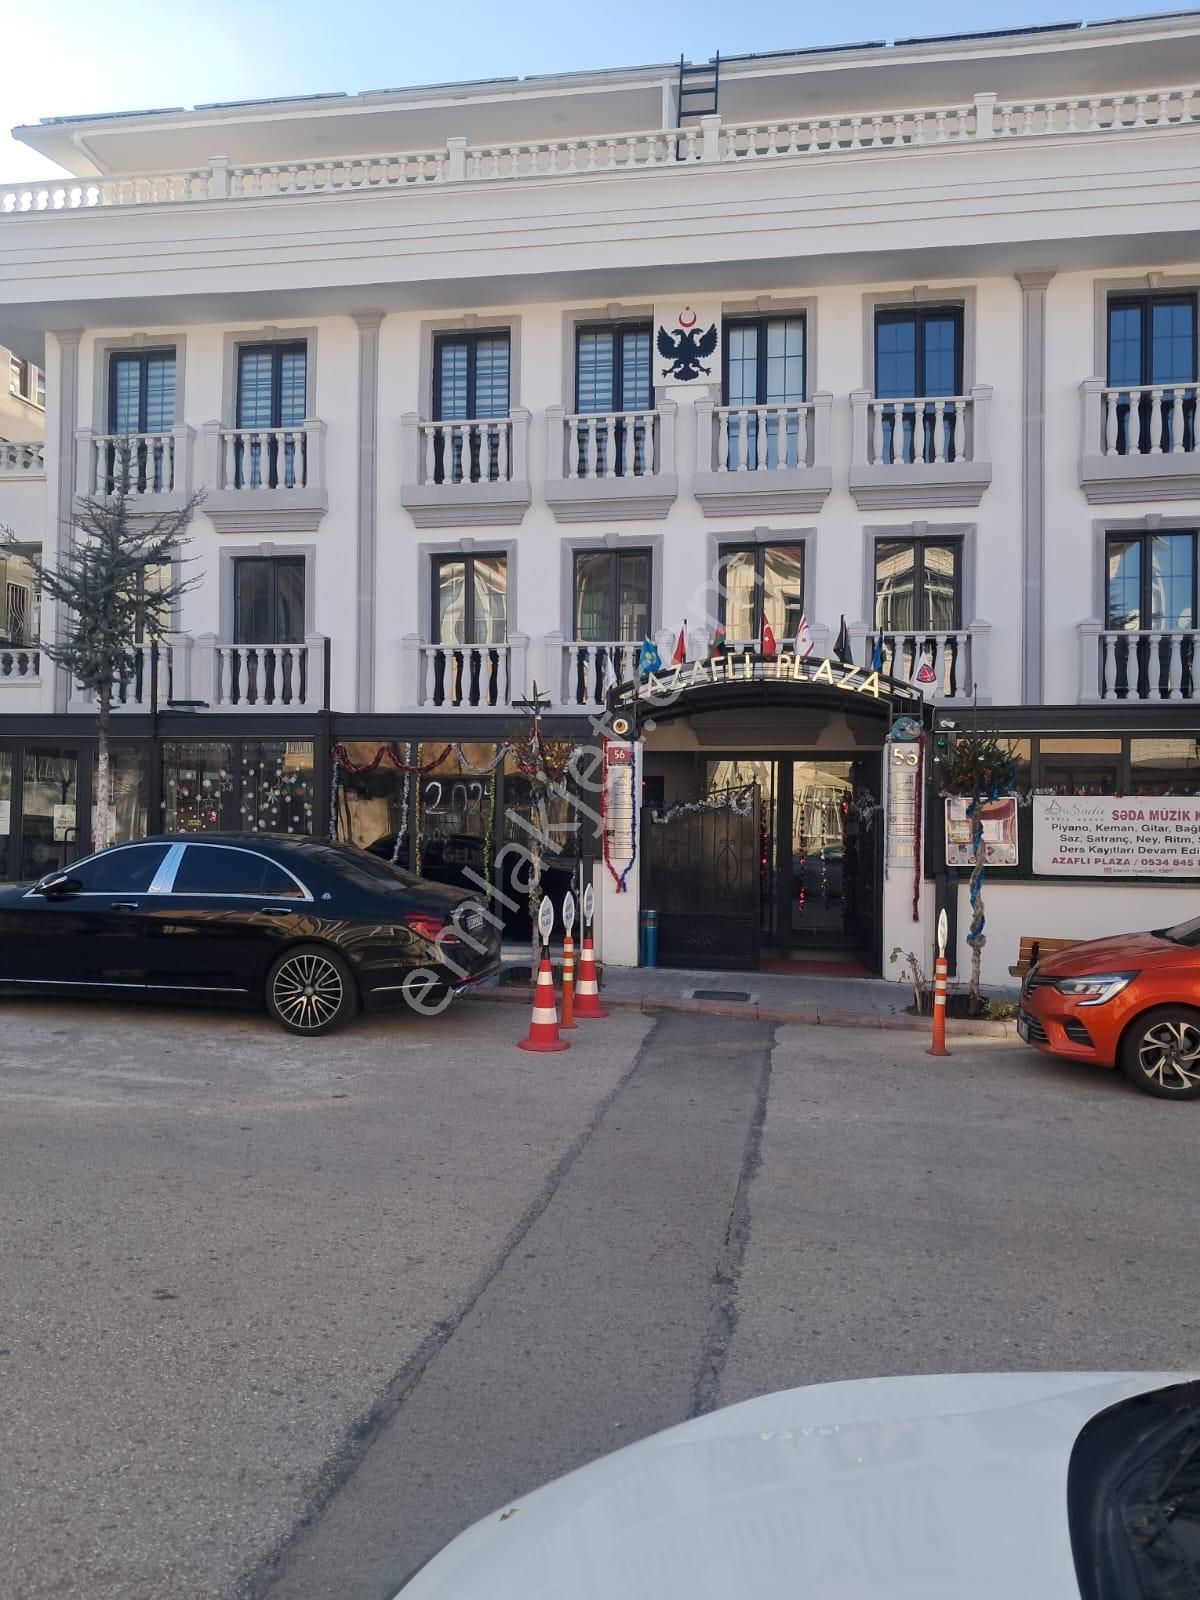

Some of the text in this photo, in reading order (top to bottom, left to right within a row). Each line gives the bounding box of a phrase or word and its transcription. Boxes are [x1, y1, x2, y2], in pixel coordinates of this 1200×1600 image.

[646, 653, 881, 698] AZAFLI PLAZA
[614, 750, 626, 760] 56
[1149, 807, 1191, 822] MÜZİK
[1051, 823, 1092, 833] Piyano,
[1096, 824, 1137, 833] Keman,
[1141, 824, 1171, 834] Gitar,
[1059, 834, 1083, 843] Saz,
[1086, 834, 1132, 845] Satranç,
[1136, 835, 1161, 845] Ney,
[1165, 836, 1194, 845] Ritm,
[1059, 845, 1086, 853] Ders
[1089, 845, 1134, 856] Kayıtları
[1138, 846, 1177, 854] Devam
[1051, 857, 1091, 865] AZAFLI
[1094, 857, 1131, 866] PLAZA
[1141, 858, 1169, 866] 0534
[1172, 858, 1194, 867] 845
